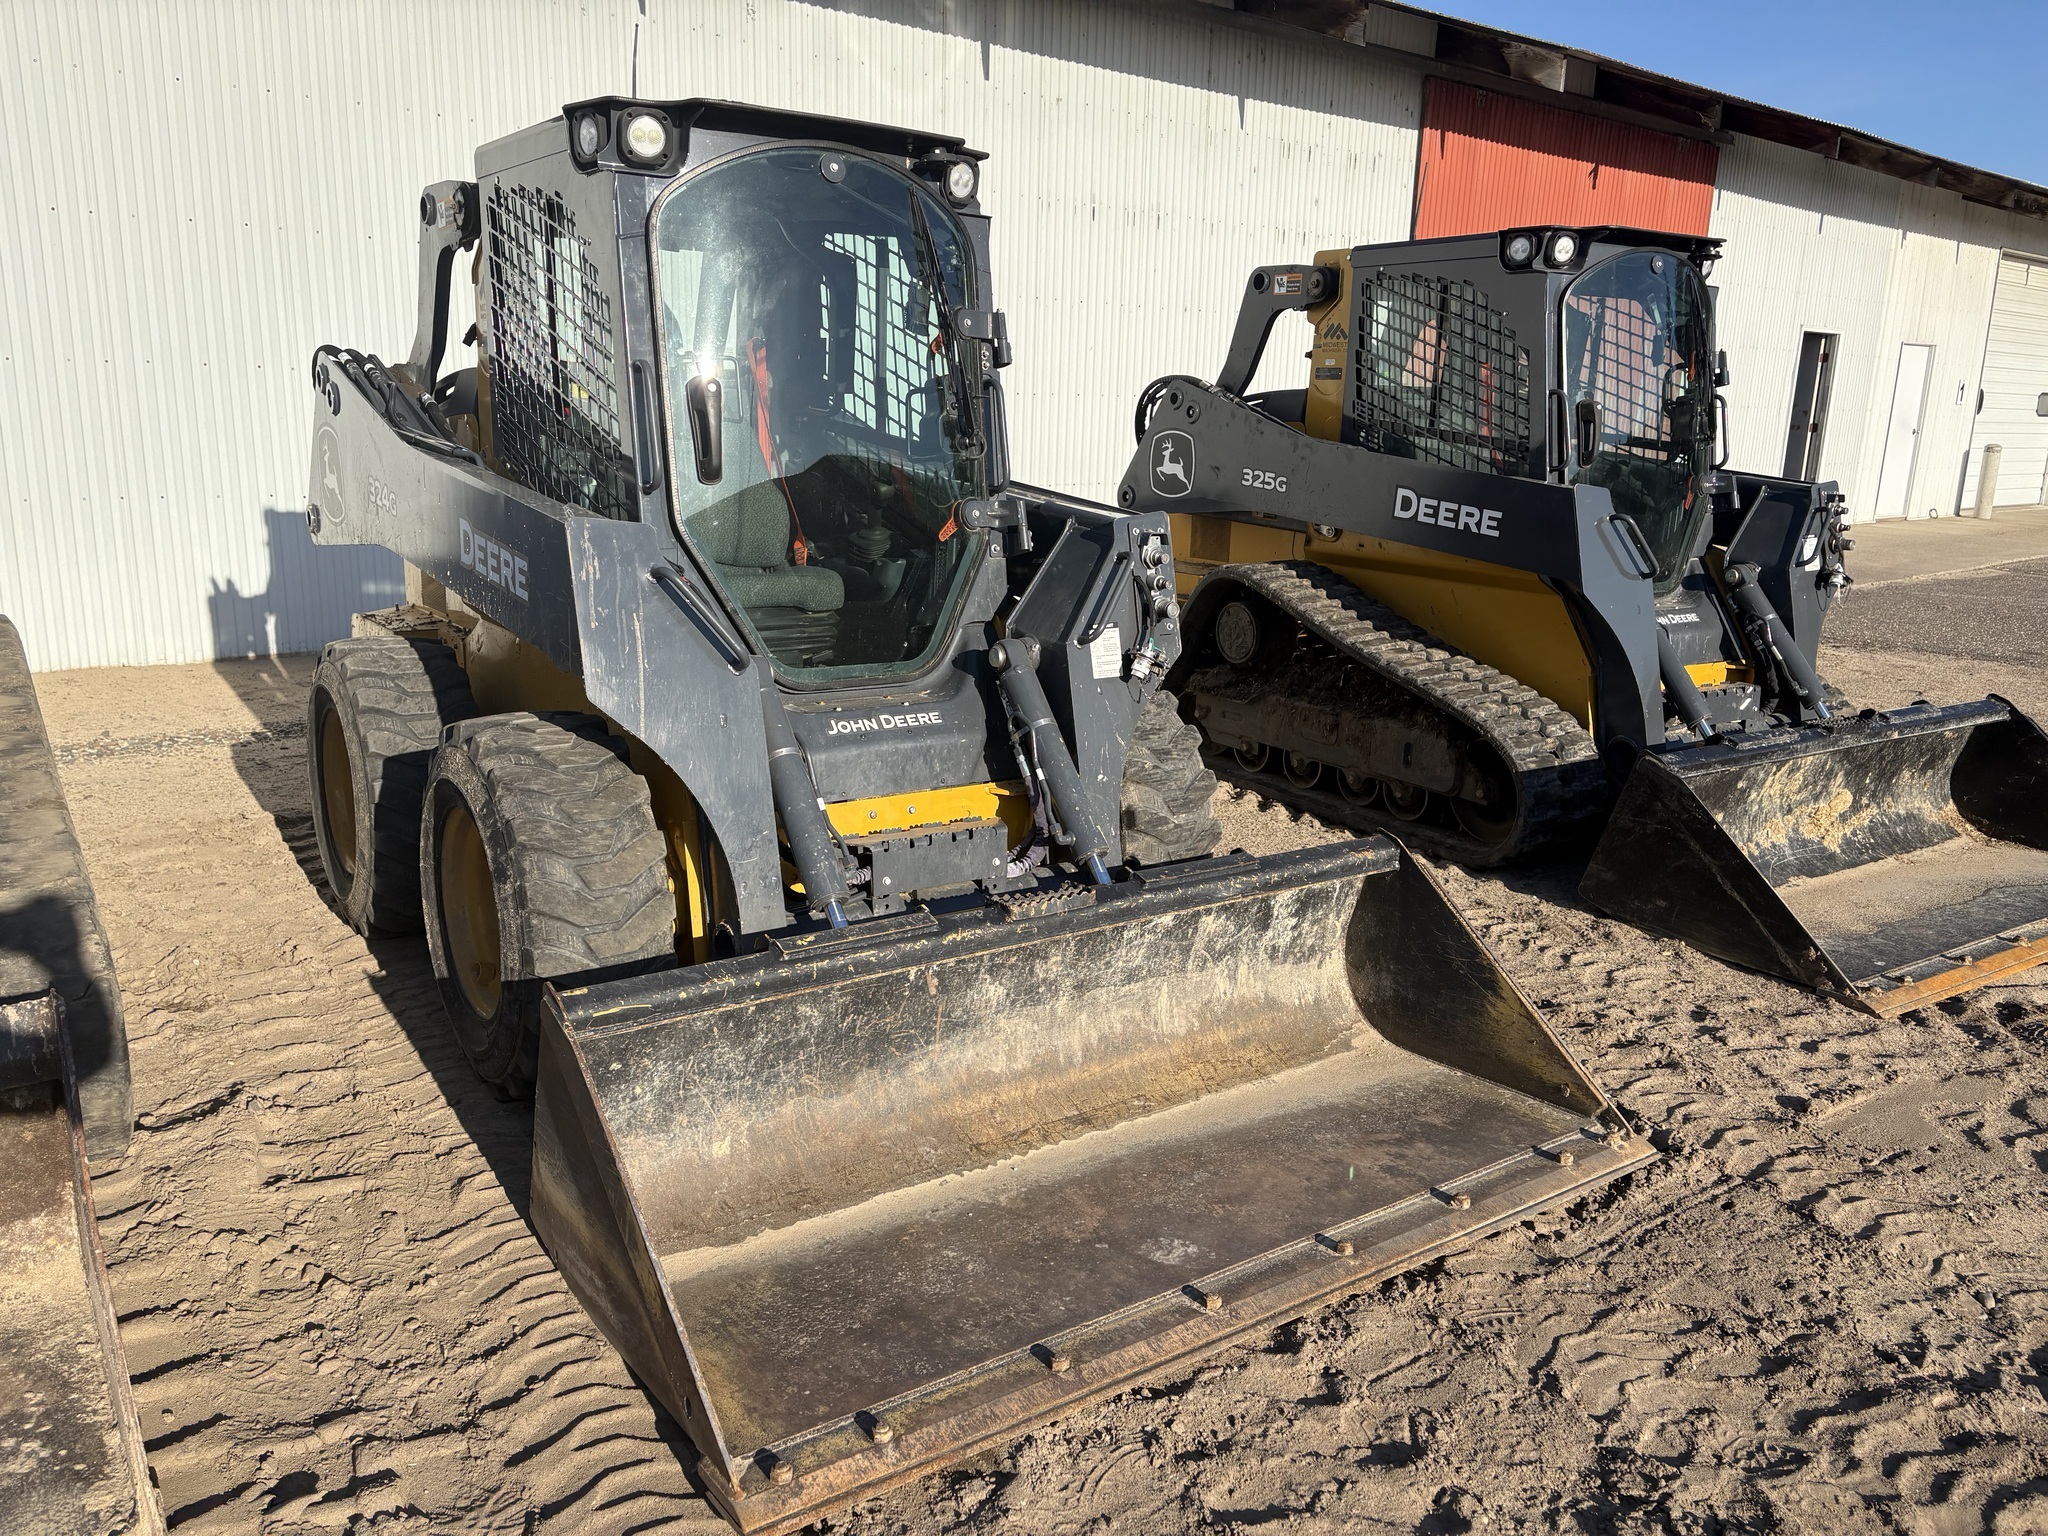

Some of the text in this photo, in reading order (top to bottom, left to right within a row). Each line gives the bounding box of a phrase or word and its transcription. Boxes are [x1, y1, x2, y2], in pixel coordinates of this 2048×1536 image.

[368, 475, 397, 517] 324G
[1241, 468, 1287, 492] 325G
[1393, 487, 1503, 537] DEERE
[459, 517, 529, 601] DEERE
[1655, 613, 1700, 625] HN DEERE
[827, 711, 943, 735] JOHN DEERE
